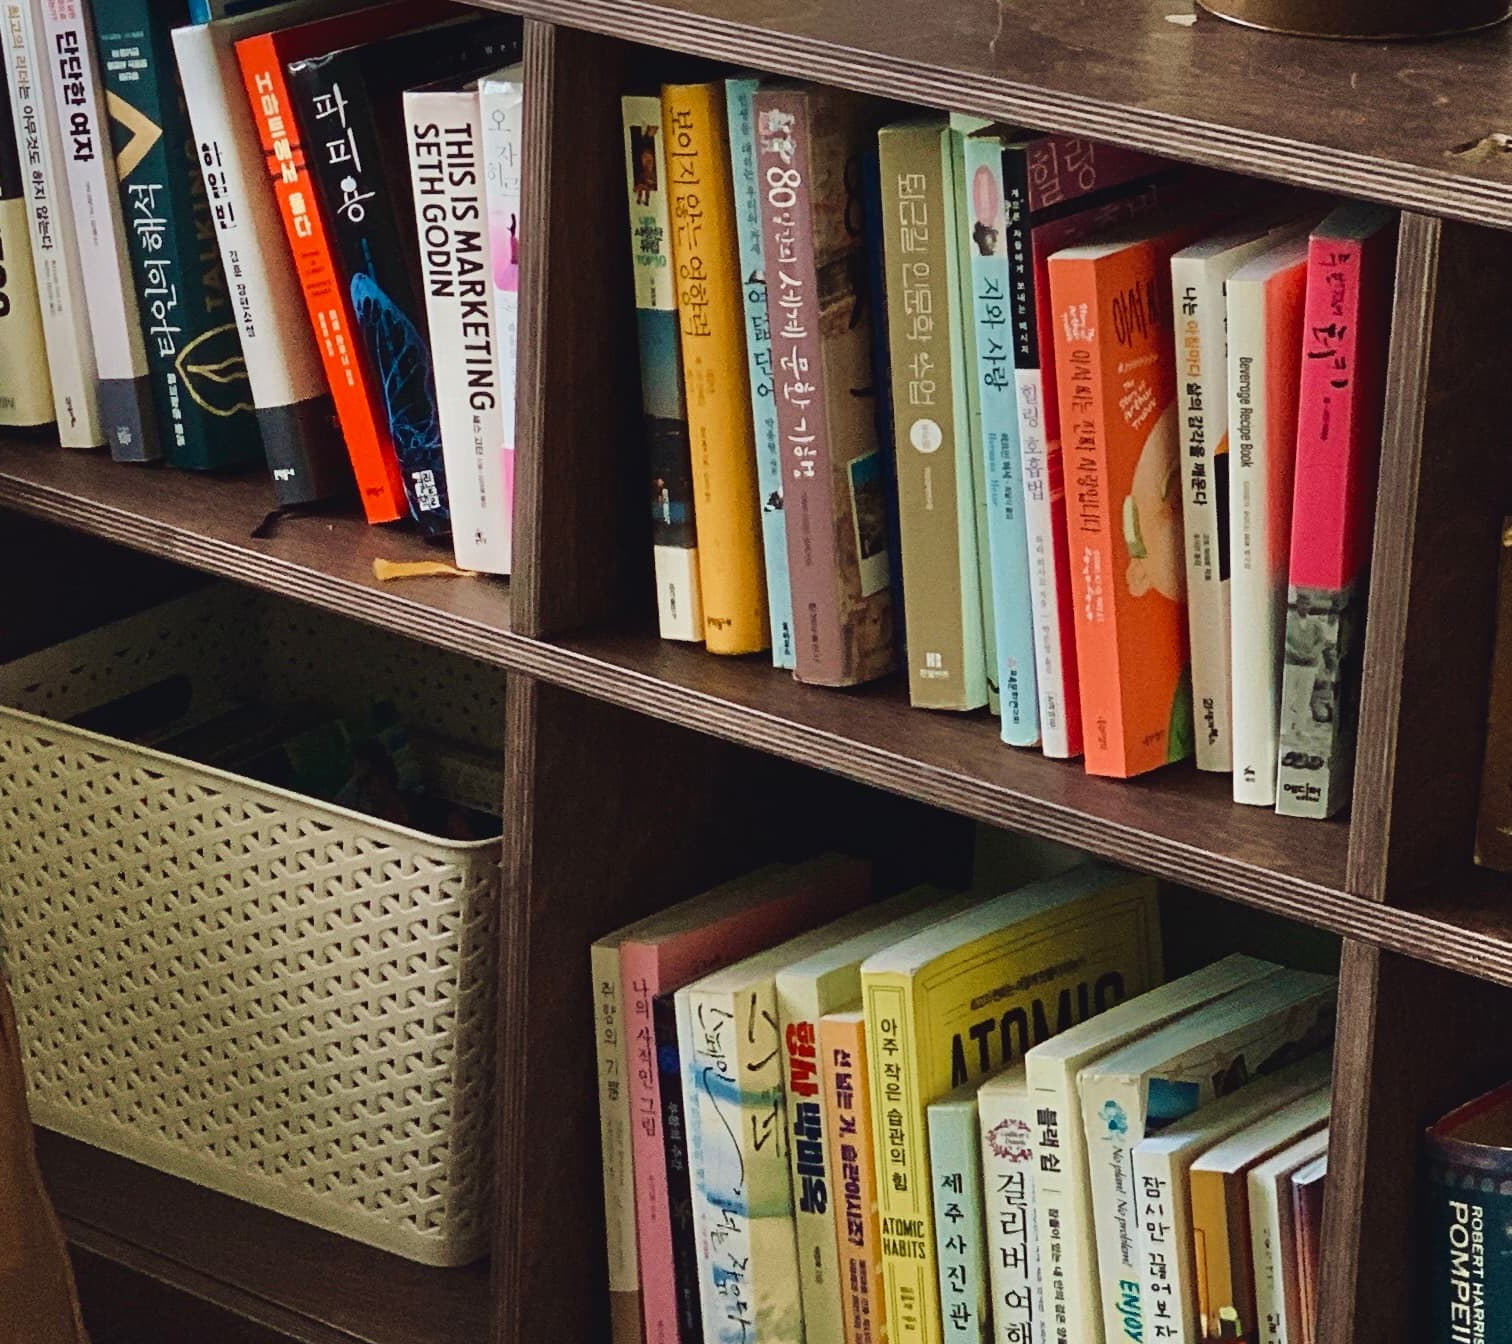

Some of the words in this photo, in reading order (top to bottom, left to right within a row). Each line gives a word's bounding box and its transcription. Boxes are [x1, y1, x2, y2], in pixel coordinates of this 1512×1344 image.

[6, 5, 26, 50] 최고의
[14, 52, 33, 100] 리더는
[56, 30, 89, 104] 단단한
[23, 106, 40, 167] 아무것도
[71, 109, 95, 162] 여자
[312, 82, 372, 222] 파피용
[443, 122, 476, 193] THIS
[669, 107, 699, 191] 보이지
[32, 169, 46, 199] 하지
[413, 123, 443, 208] SETH
[1031, 139, 1096, 207] 힐링
[36, 200, 55, 250] 않는다
[129, 182, 165, 250] 해석
[453, 197, 480, 226] IS
[675, 196, 705, 252] 않는
[767, 167, 802, 266] 80일간의
[898, 174, 928, 253] 퇴근길
[422, 214, 455, 298] GODIN
[140, 258, 182, 358] 타인의
[455, 229, 495, 412] MARKETING
[681, 258, 712, 339] 영향력
[778, 270, 807, 339] 세계
[900, 262, 934, 345] 인문학
[978, 276, 1005, 328] 지와
[1184, 285, 1199, 315] 나는
[983, 336, 1009, 392] 사랑
[1185, 320, 1202, 376] 아침마다
[908, 353, 936, 407] 수업
[1022, 384, 1038, 428] 힐링
[1187, 380, 1203, 410] 삶의
[1238, 356, 1253, 404] Beverage
[787, 419, 816, 480] 기행
[1188, 414, 1205, 456] 감각을
[1239, 407, 1254, 440] Recipe
[1190, 460, 1207, 505] 깨운다
[1241, 443, 1254, 468] Book
[1074, 456, 1104, 533] 사랑입니다
[631, 979, 650, 1020] 나의
[833, 1045, 850, 1065] 선
[881, 1018, 899, 1057] 아주
[952, 971, 1125, 1089] ATOMIC
[636, 1027, 655, 1092] 사적인
[785, 1020, 820, 1099] 형사
[835, 1068, 855, 1108] 넘는
[884, 1063, 901, 1103] 작은
[641, 1096, 657, 1137] 그림
[887, 1108, 907, 1167] 습관의
[1036, 1108, 1060, 1149] 블랙
[790, 1101, 828, 1215] 박미옥
[891, 1171, 908, 1192] 힘
[1040, 1153, 1062, 1174] 쉽
[841, 1140, 864, 1248] 습관이시죠?
[1142, 1176, 1170, 1243] 잠시만
[882, 1217, 925, 1240] ATOMIC
[882, 1236, 926, 1261] HABITS
[941, 1173, 971, 1331] 제주사진관
[997, 1171, 1028, 1280] 걸리버
[1471, 1205, 1485, 1279] ROBERT
[1448, 1200, 1472, 1344] POMPEII
[1119, 1278, 1144, 1342] ENJOY
